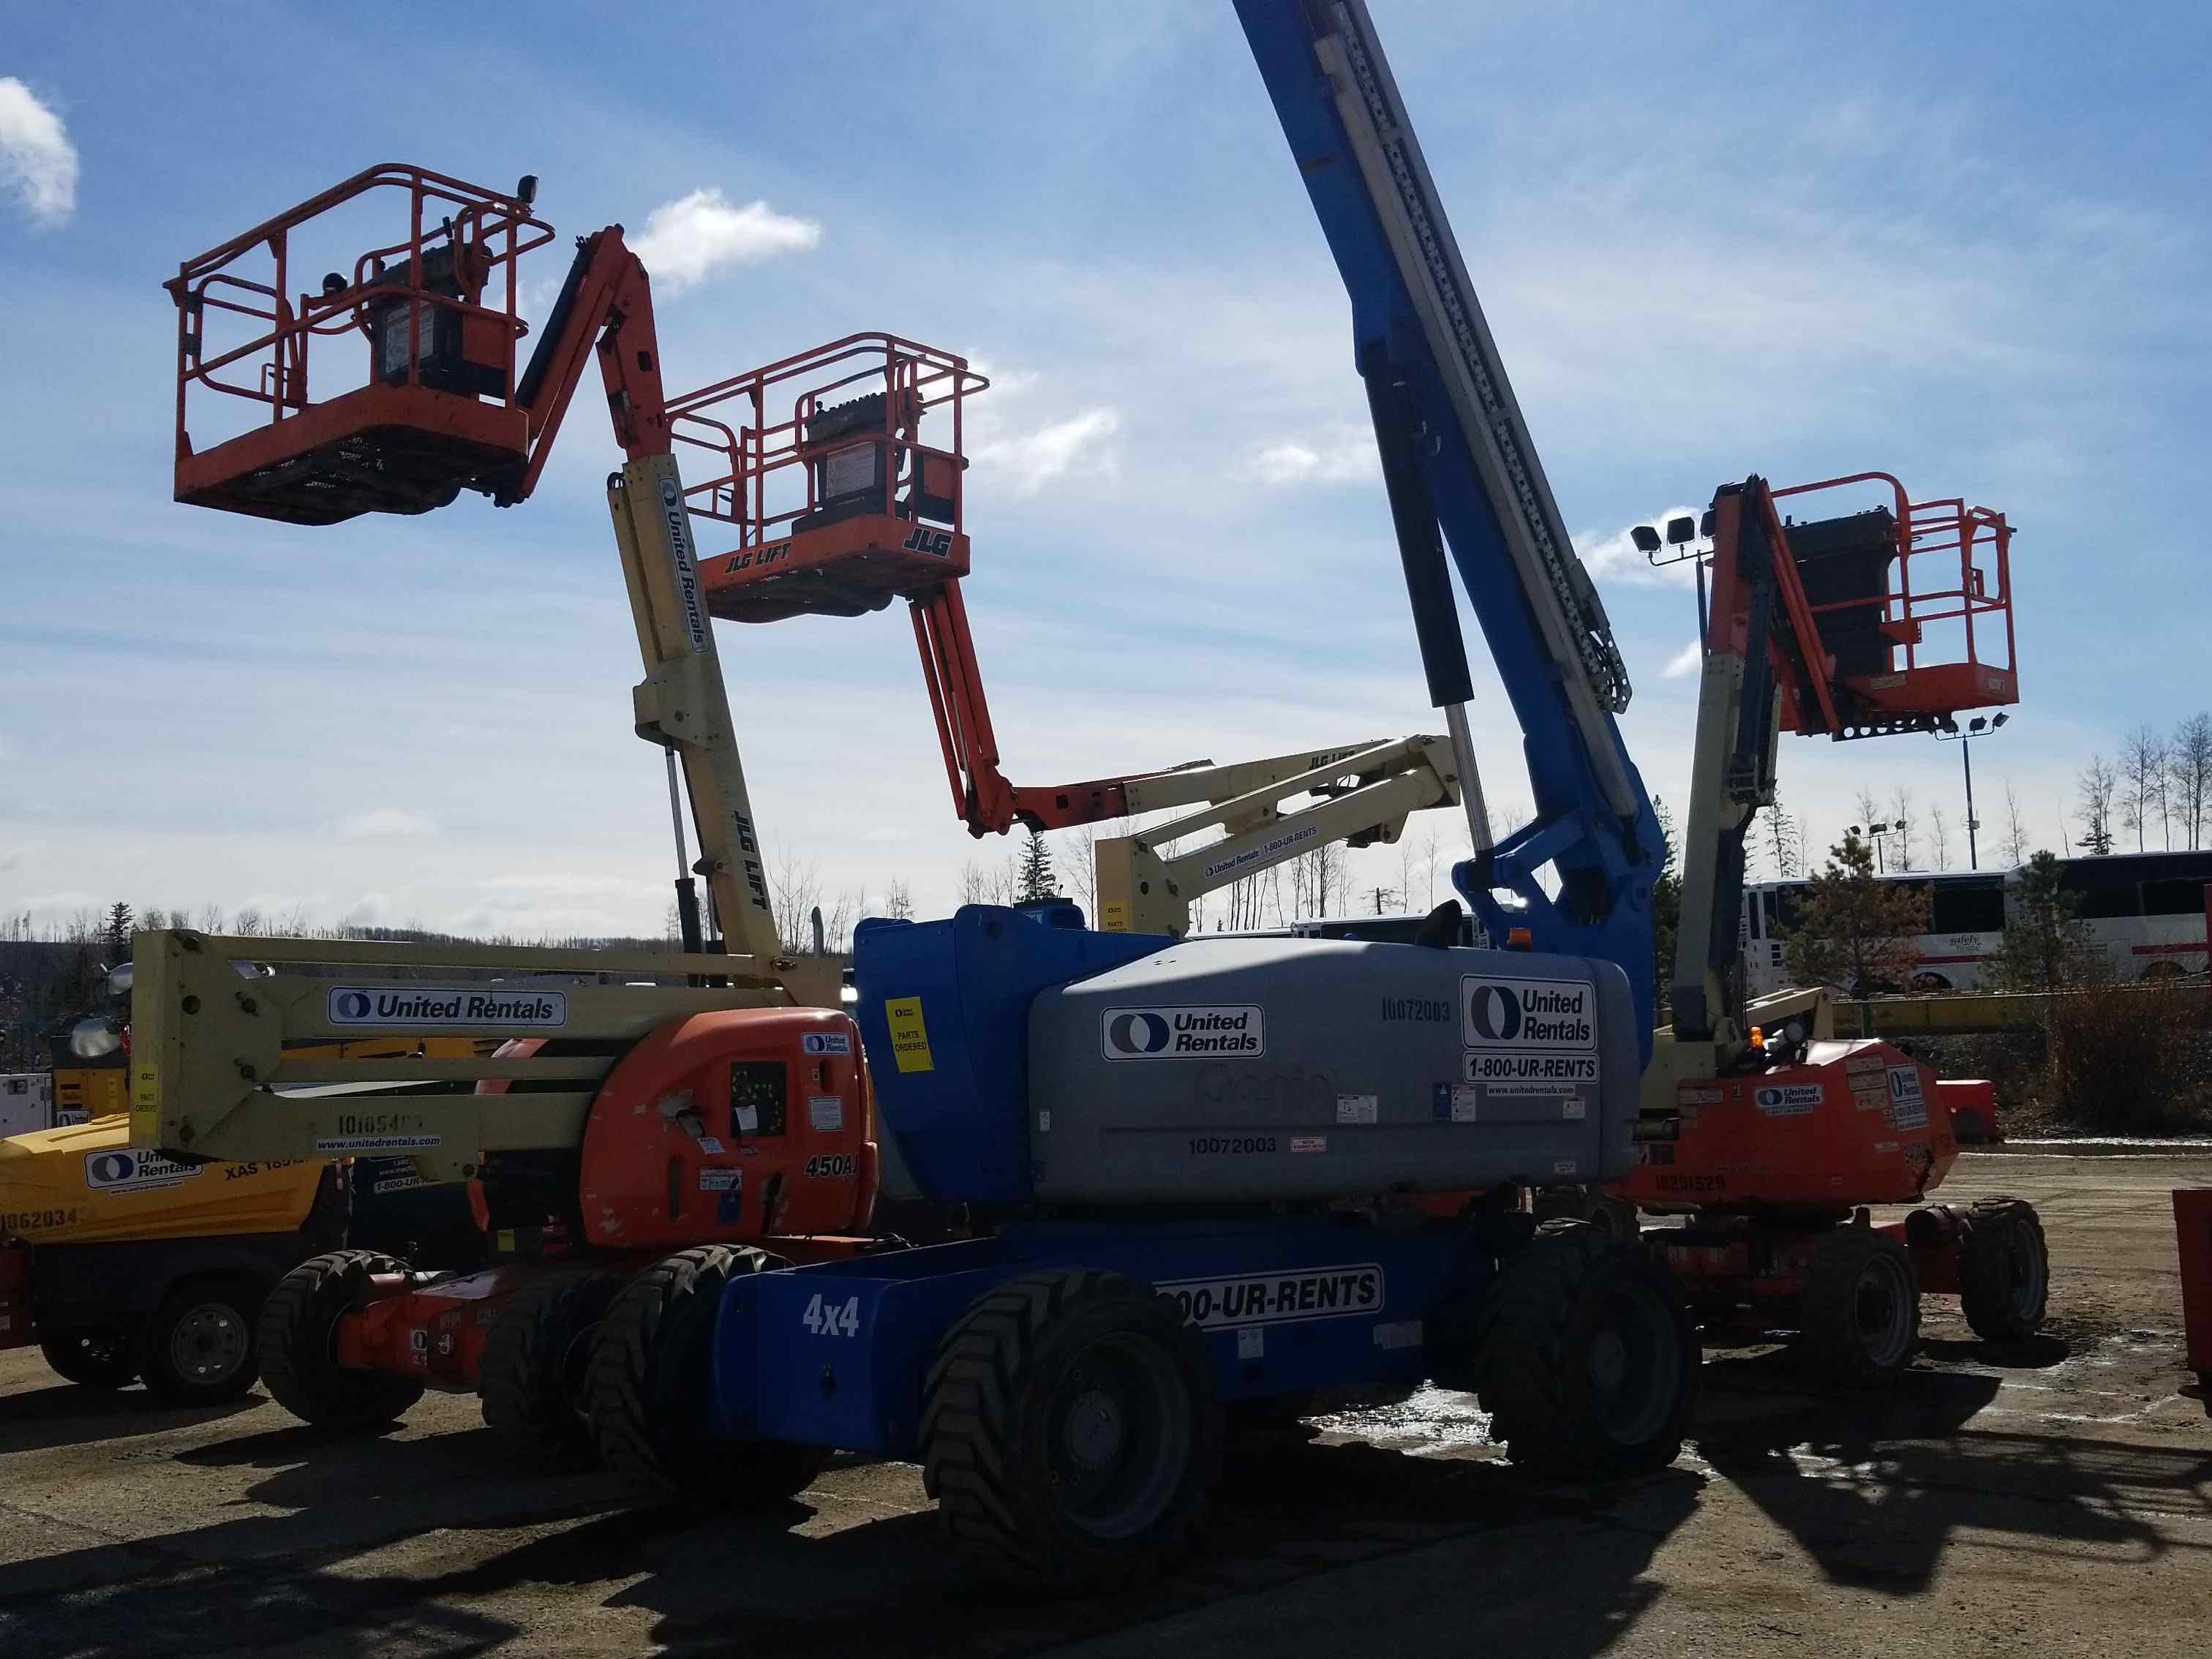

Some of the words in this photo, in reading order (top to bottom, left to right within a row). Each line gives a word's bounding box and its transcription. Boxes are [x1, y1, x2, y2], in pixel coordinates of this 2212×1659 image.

[901, 527, 953, 558] JLG
[725, 552, 753, 574] JLG
[755, 542, 792, 565] LIFT
[667, 511, 691, 572] United
[682, 575, 706, 644] Rentals
[1214, 858, 1235, 873] United
[1237, 848, 1260, 866] Rentals
[1264, 826, 1317, 854] 1-800-UR-RENTS
[734, 810, 756, 854] JLG
[745, 859, 767, 911] LIFT
[377, 995, 462, 1019] United
[466, 996, 554, 1020] Rentals
[1521, 989, 1583, 1014] United
[1175, 1012, 1248, 1031] United
[1523, 1016, 1590, 1040] Rentals
[825, 1035, 846, 1044] United
[897, 1030, 919, 1039] PARTS
[1175, 1032, 1257, 1052] Rentals
[826, 1043, 849, 1053] Rentals
[895, 1041, 927, 1053] ORDERED
[1469, 1057, 1595, 1077] 1-800-UR-RENTS
[1488, 1086, 1574, 1095] www.unitedrentals.com
[1783, 1086, 1817, 1096] United
[1784, 1095, 1821, 1105] Rentals
[317, 1136, 440, 1151] www.unitedrentals.com
[1187, 1137, 1277, 1155] 10072003
[223, 1162, 258, 1181] XAS
[805, 1153, 859, 1178] 450AJ
[802, 1293, 860, 1338] 4x4
